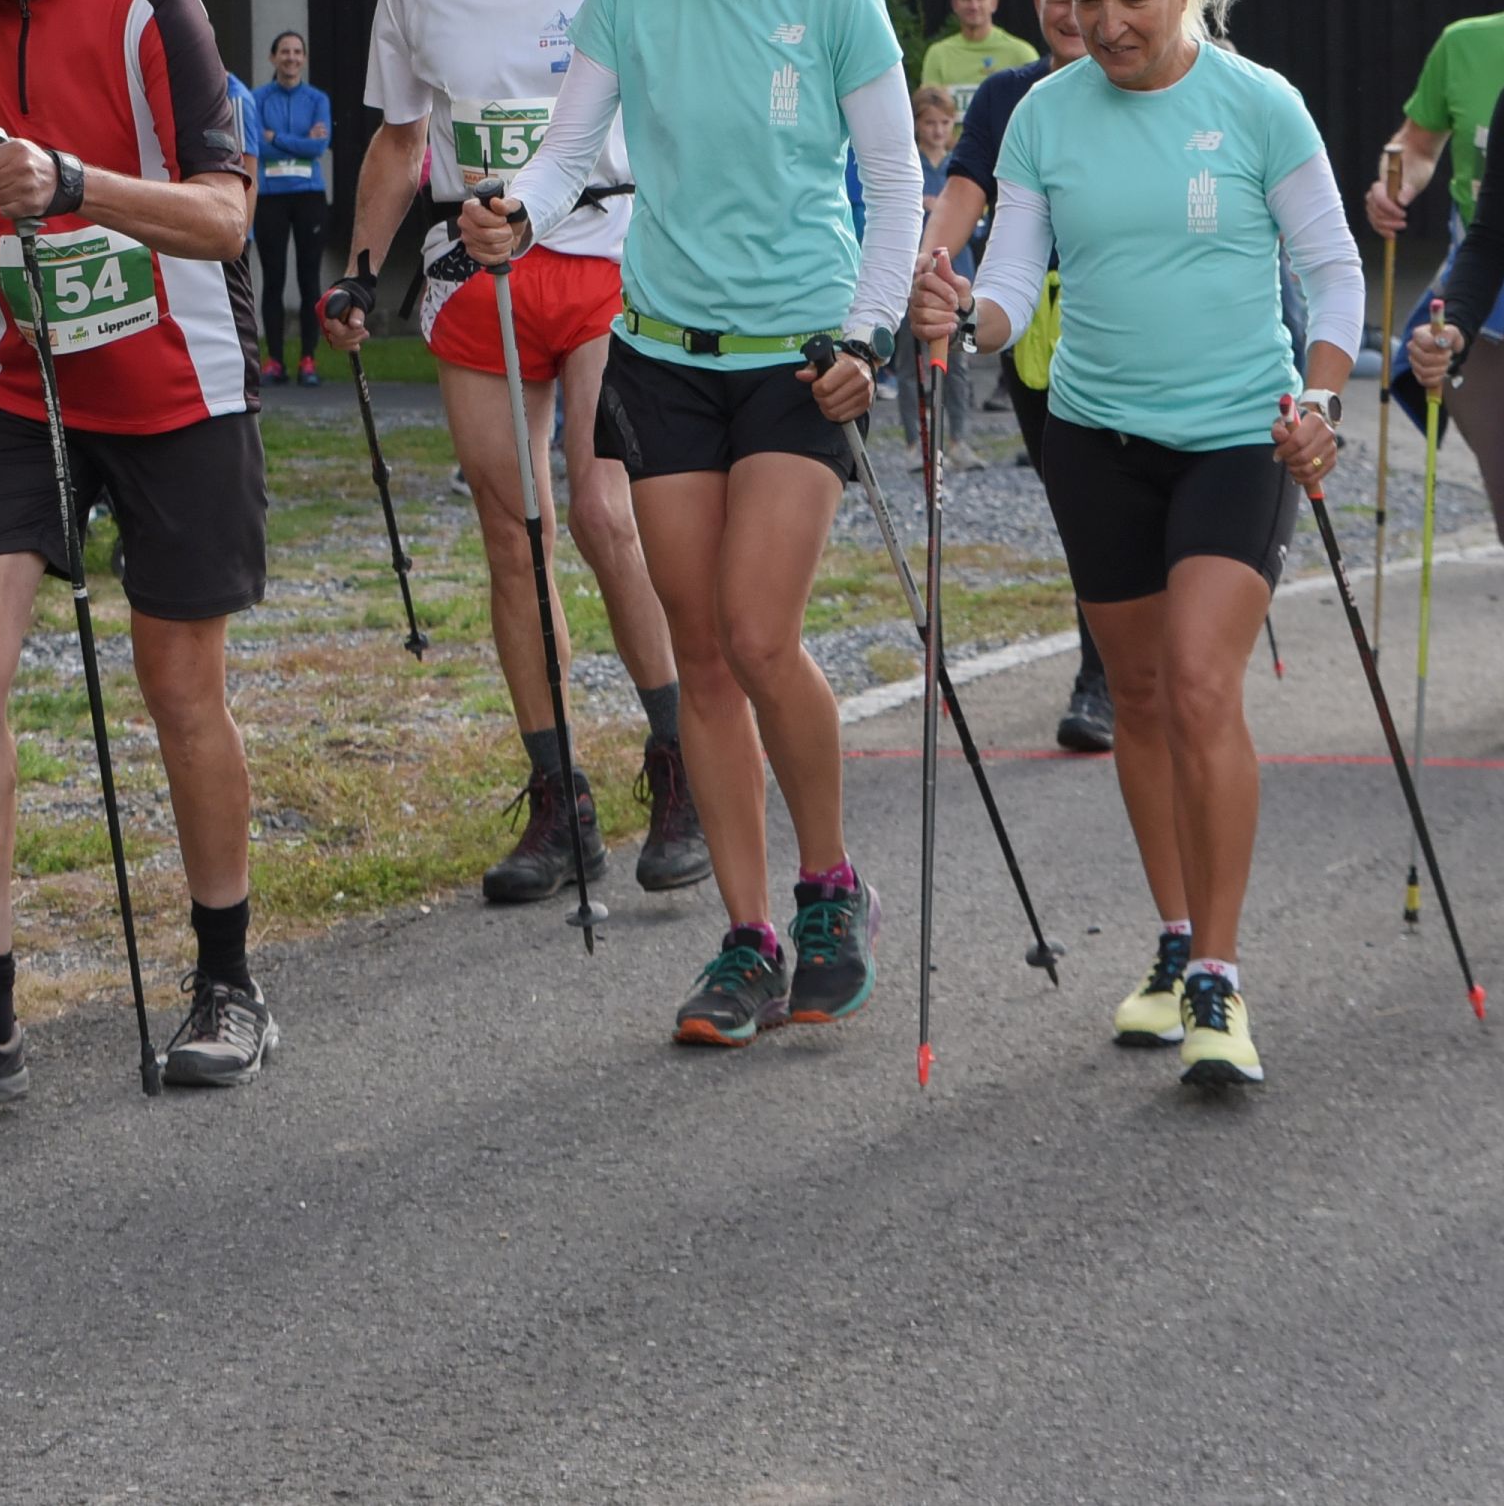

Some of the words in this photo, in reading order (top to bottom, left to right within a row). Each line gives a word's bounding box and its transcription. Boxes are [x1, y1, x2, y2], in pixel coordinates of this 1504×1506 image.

[771, 62, 800, 87] AUF
[770, 96, 799, 110] LAUF
[1188, 167, 1217, 195] AUF
[1188, 204, 1217, 218] LAUF
[23, 256, 129, 314] 54
[97, 310, 152, 335] Lippuner
